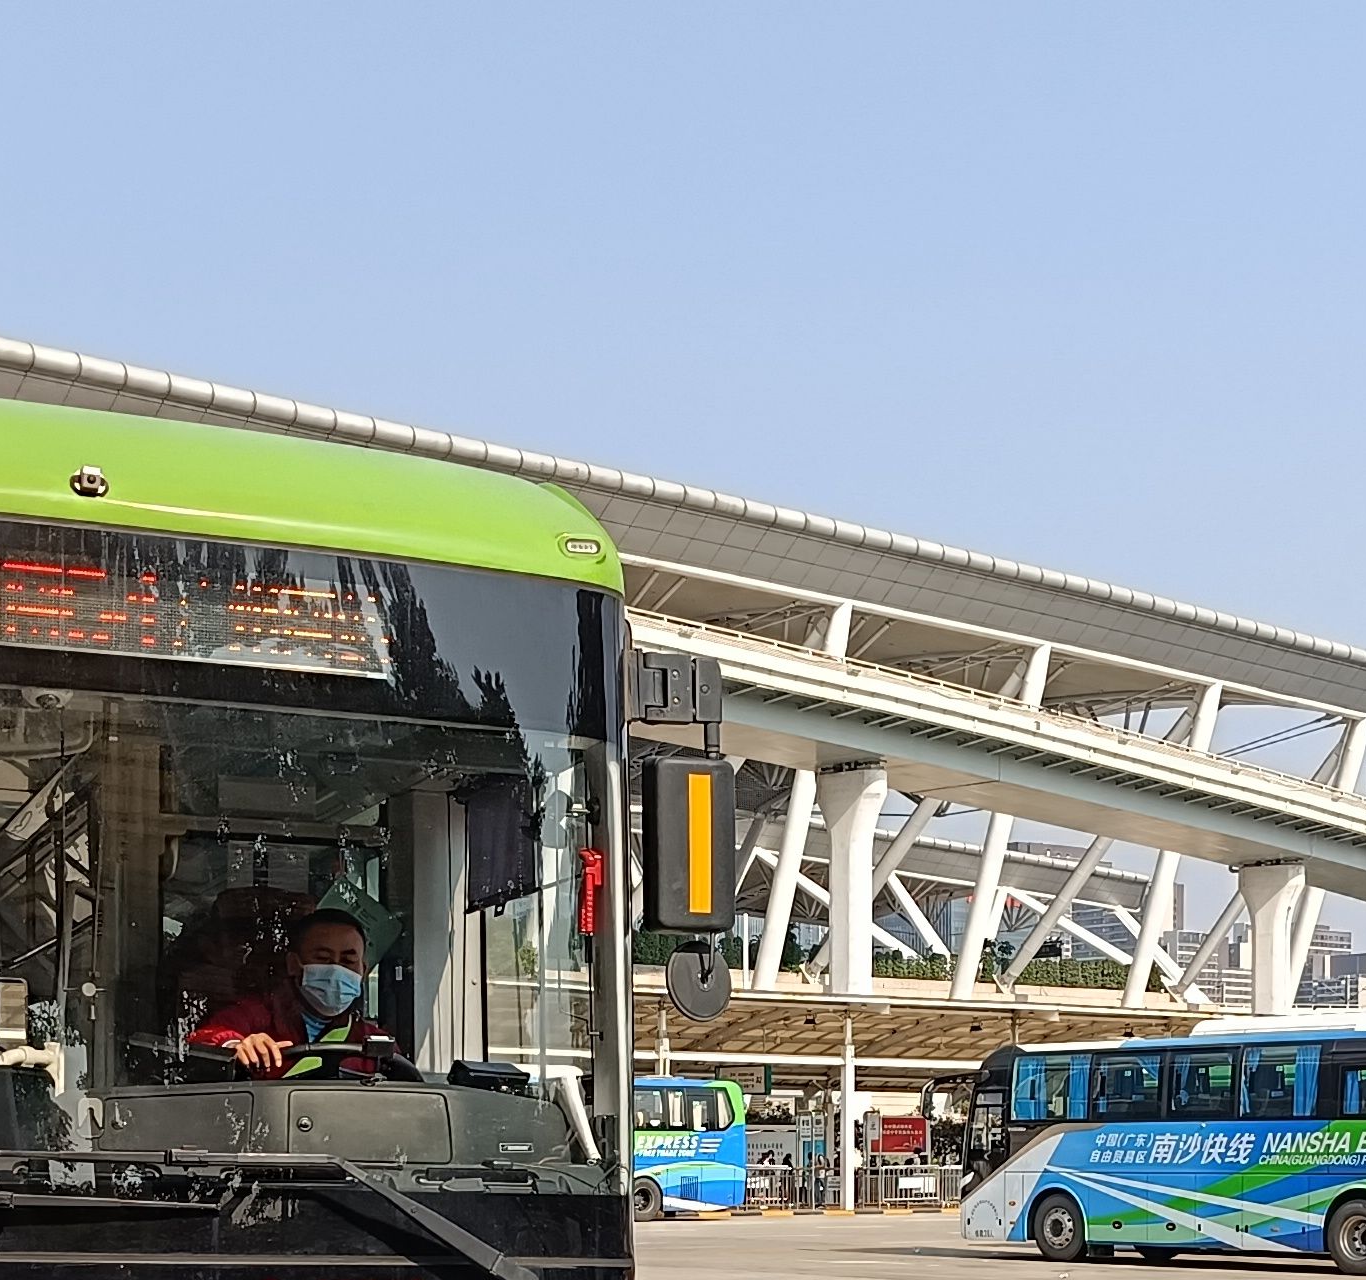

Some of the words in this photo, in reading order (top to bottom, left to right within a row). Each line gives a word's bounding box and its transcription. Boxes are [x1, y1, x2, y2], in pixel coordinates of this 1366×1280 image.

[637, 1135, 700, 1149] EXPRESS
[1149, 1133, 1255, 1165] 南沙快线
[1262, 1131, 1351, 1153] NANSHA
